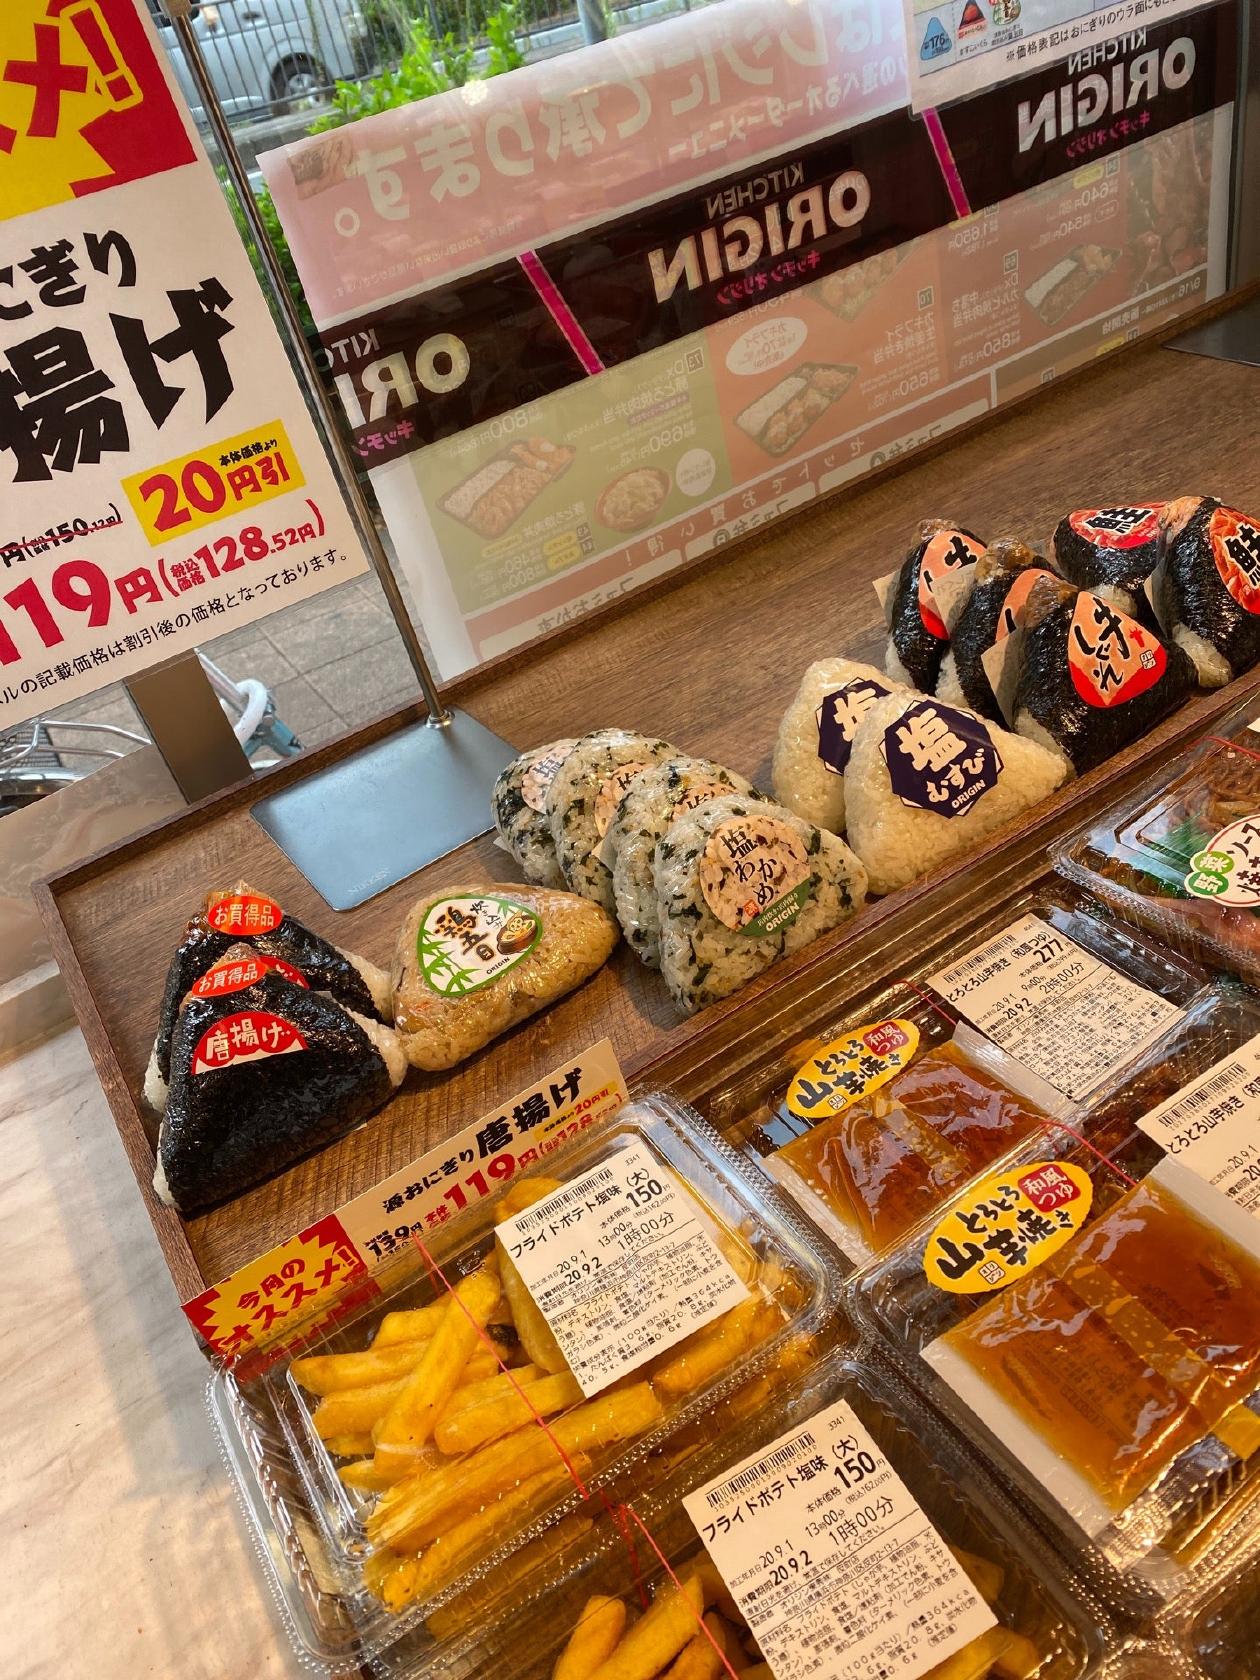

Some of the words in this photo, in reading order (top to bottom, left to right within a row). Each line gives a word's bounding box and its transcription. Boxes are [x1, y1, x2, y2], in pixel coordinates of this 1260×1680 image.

[0, 3, 142, 153] メ!
[950, 778, 988, 811] ORIGIN
[213, 902, 275, 927] お買得品
[763, 900, 801, 933] ORIGIN
[198, 962, 259, 994] お買得品
[205, 1018, 291, 1062] 唐揚げ
[1165, 1091, 1246, 1158] とろとろ山芋焼き
[509, 1182, 623, 1260] フライドポテト塩味
[701, 1454, 829, 1543] フライドポテト塩味
[804, 1486, 842, 1514] 本体価格
[737, 1579, 775, 1609] 消費期限
[768, 1549, 813, 1587] 20.9.2
[827, 1493, 898, 1549] 1時00分
